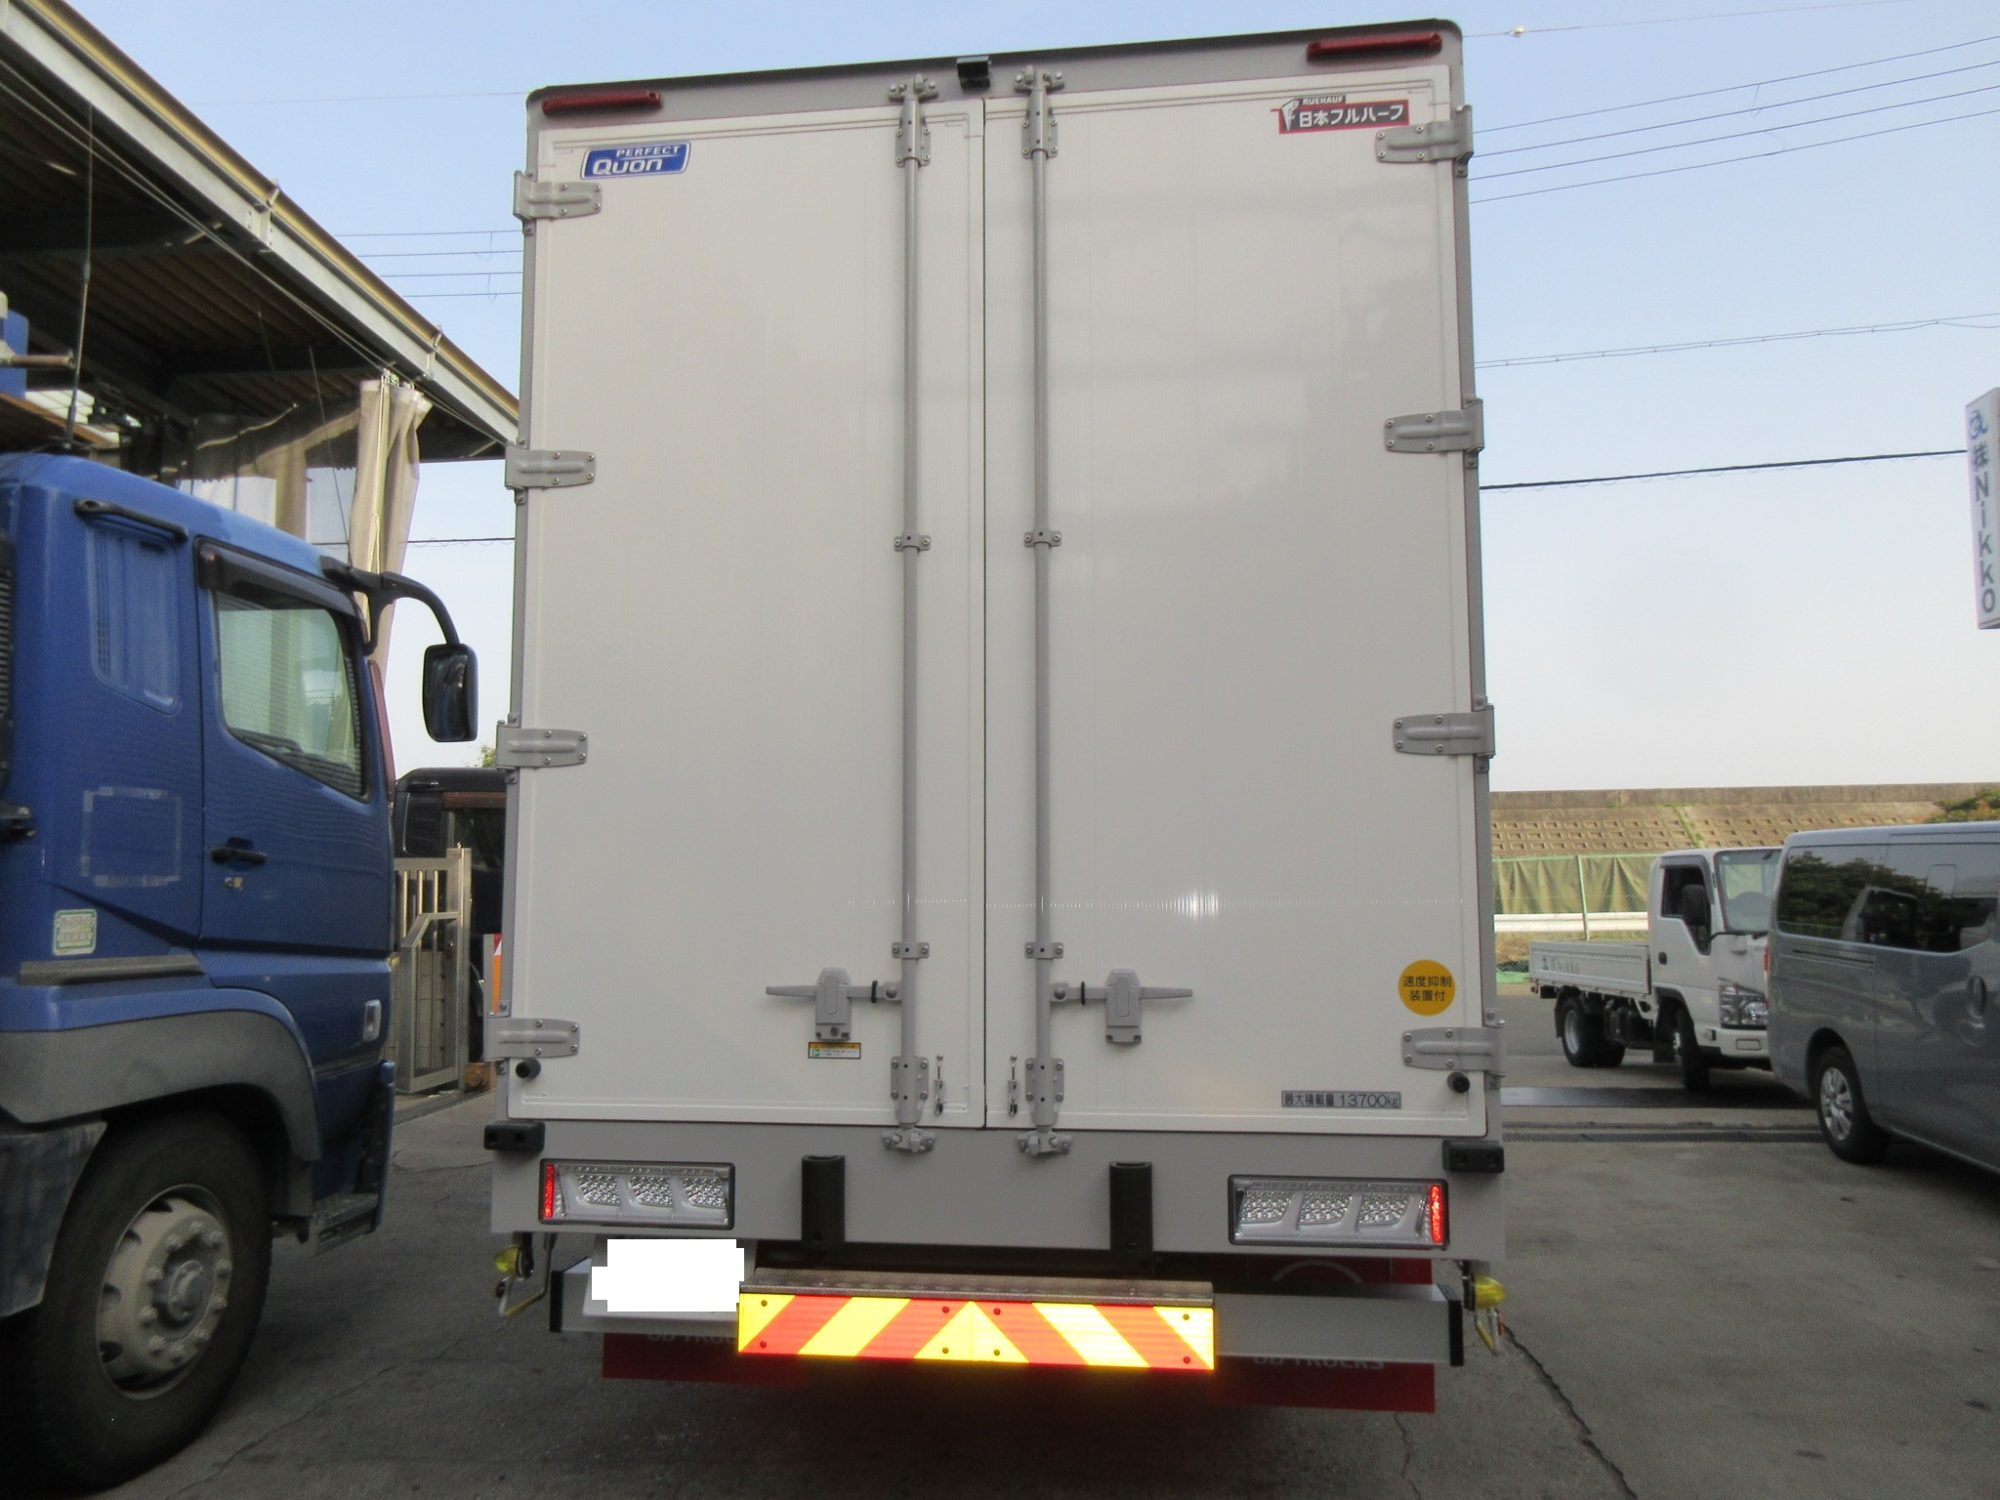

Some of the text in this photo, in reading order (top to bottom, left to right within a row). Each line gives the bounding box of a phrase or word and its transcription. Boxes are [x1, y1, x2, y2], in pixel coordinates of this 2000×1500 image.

[1299, 104, 1404, 128] 日本フルハーフ
[616, 145, 681, 158] PERFECT
